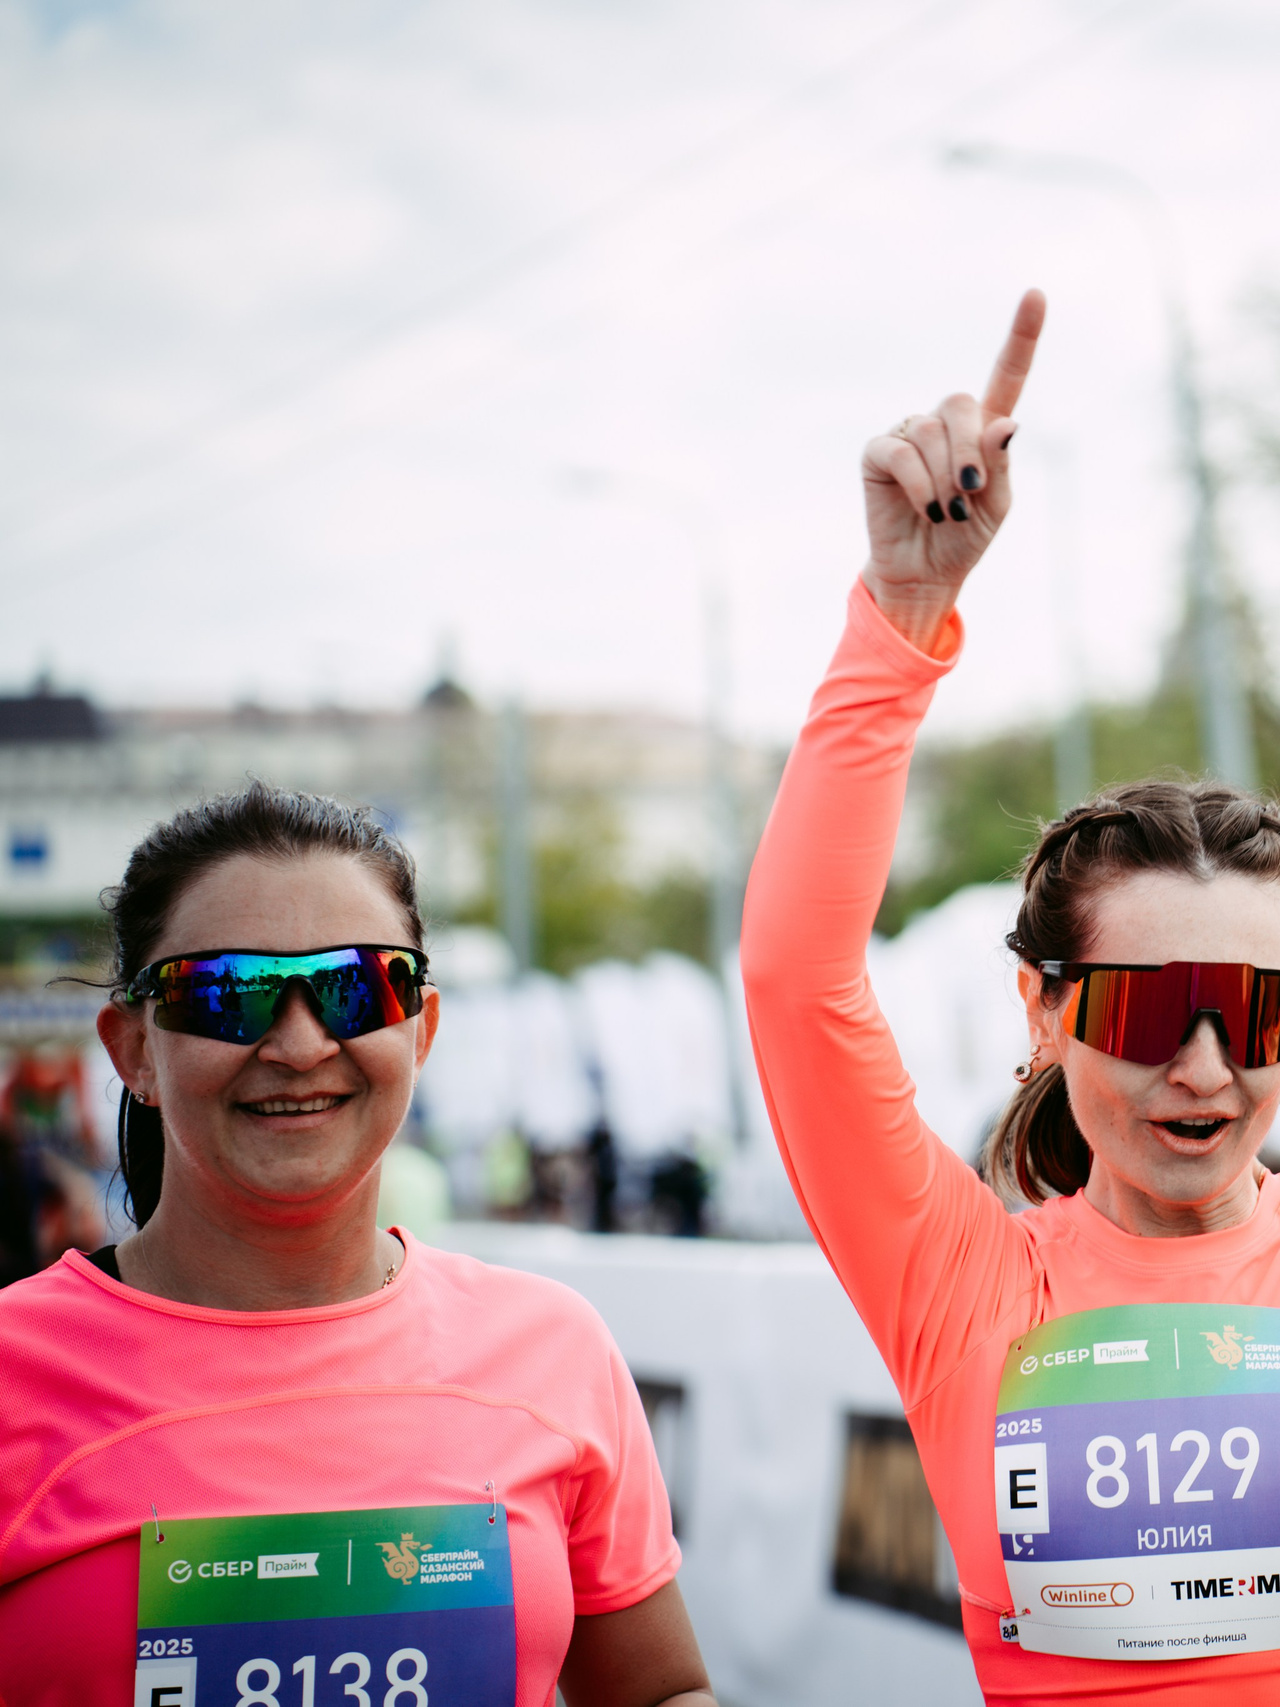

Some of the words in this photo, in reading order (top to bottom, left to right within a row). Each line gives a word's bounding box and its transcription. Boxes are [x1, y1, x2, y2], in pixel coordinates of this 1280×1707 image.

[1042, 1348, 1090, 1368] СБЕР
[1099, 1344, 1139, 1361] Прайм
[996, 1418, 1043, 1438] 2025
[1085, 1426, 1260, 1509] 8129
[1009, 1469, 1038, 1509] E
[1137, 1524, 1213, 1550] ЮЛИЯ
[420, 1550, 479, 1563] СБЕРПРАЙМ
[198, 1561, 254, 1578] СБЕР
[264, 1559, 308, 1573] Прайм
[420, 1560, 485, 1574] КАЗАНСКИЙ
[420, 1571, 473, 1584] МАРАФОН
[1048, 1589, 1107, 1602] Winline
[139, 1638, 193, 1657] 2025
[1117, 1638, 1165, 1650] Питание
[1167, 1638, 1200, 1648] после
[1203, 1634, 1247, 1646] финиша
[235, 1647, 428, 1707] 8138
